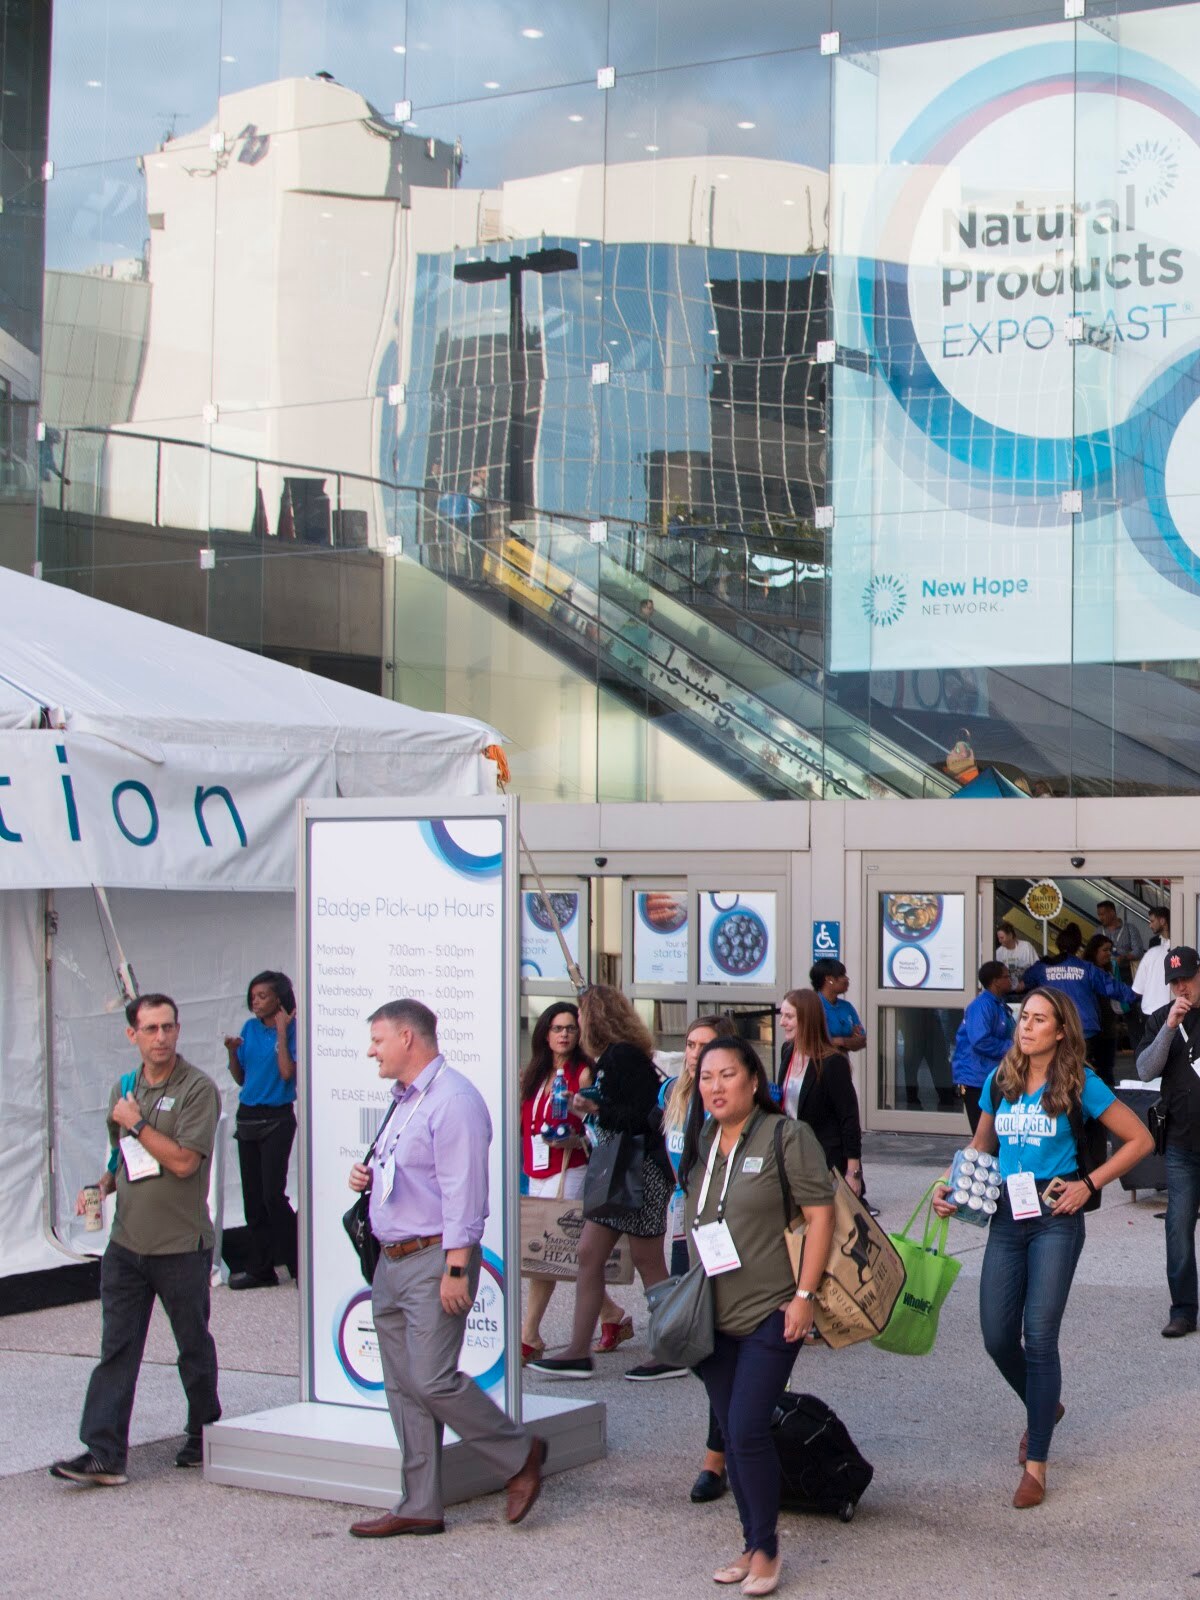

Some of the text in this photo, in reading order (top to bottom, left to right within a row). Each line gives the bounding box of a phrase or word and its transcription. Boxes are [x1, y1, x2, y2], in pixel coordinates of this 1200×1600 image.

[942, 184, 1136, 249] Natural
[942, 242, 1184, 306] Products
[942, 316, 1054, 358] EXPO
[922, 576, 1029, 598] New Hope
[922, 602, 999, 616] NETWORK
[317, 896, 495, 922] Badge Pick-up Hours
[317, 944, 356, 957] Monday
[388, 944, 425, 956] 7:00am
[435, 944, 474, 957] 5:00pm
[653, 948, 682, 958] starts
[317, 964, 356, 978] Tuesday
[388, 964, 425, 977] 7:00am
[435, 965, 474, 978] 5:00pm
[1046, 971, 1084, 981] SECURITY
[317, 984, 373, 998] Wednesday
[388, 985, 424, 998] 7:00am
[435, 986, 474, 1000] 6:00pm
[317, 1004, 360, 1018] Thursday
[317, 1024, 346, 1038] Friday
[317, 1044, 359, 1058] Saturday
[331, 1088, 392, 1102] PLEASE HAVE
[339, 1146, 365, 1159] Photo
[467, 1317, 498, 1332] ucts
[466, 1335, 496, 1350] EAST
